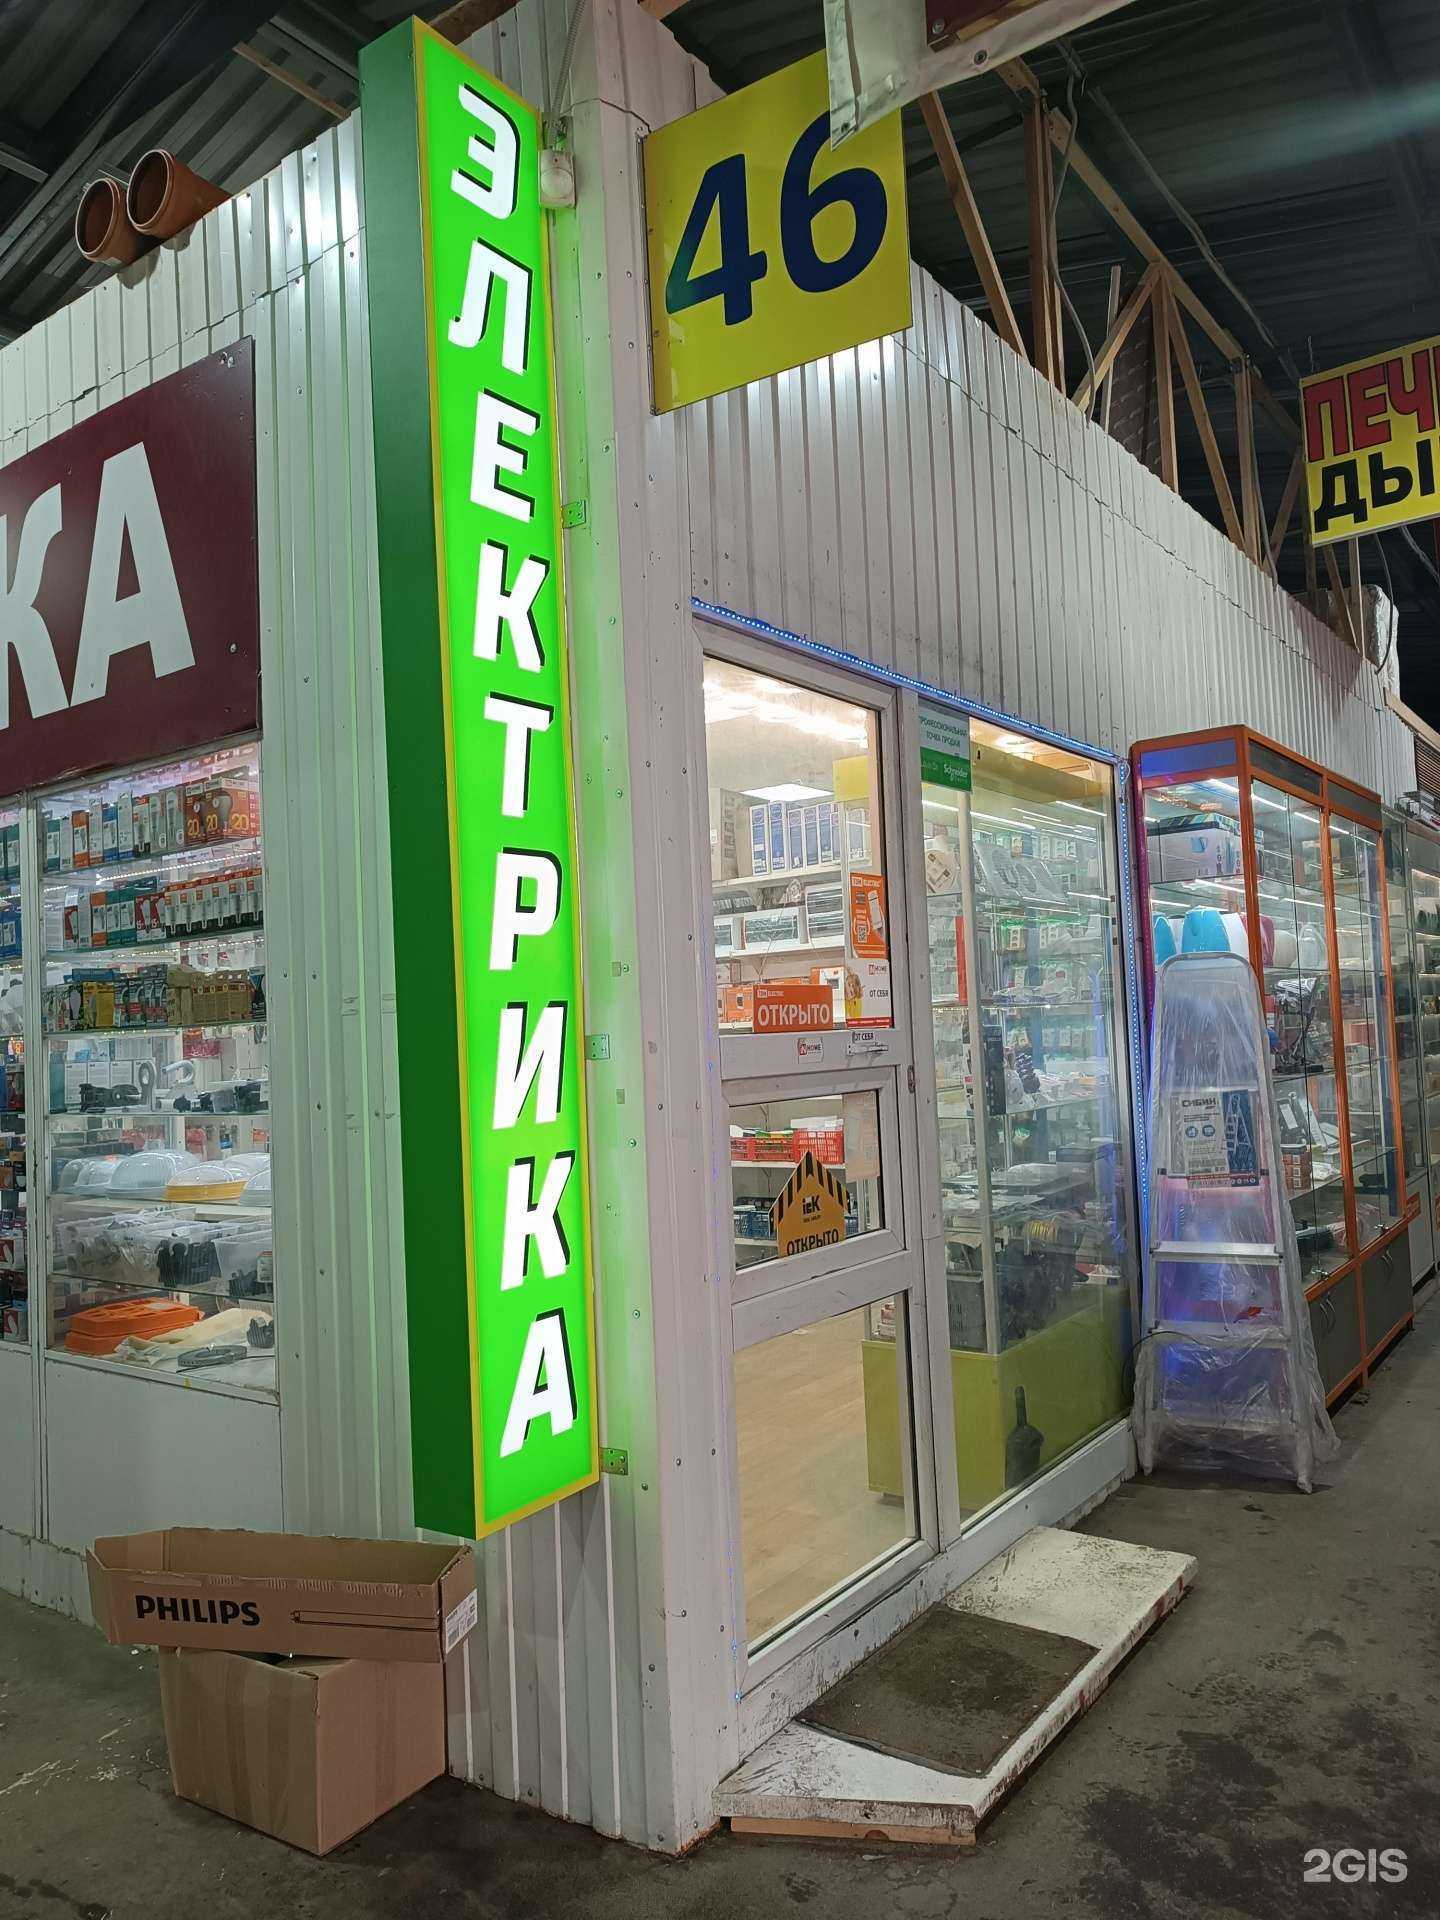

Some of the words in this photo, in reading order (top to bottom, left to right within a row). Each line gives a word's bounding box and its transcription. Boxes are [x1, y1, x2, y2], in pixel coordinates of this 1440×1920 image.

[665, 109, 888, 326] 46
[1302, 345, 1440, 463] ПЕЧ
[447, 82, 577, 1458] ЭЛЕКТРИКА
[757, 1004, 830, 1026] ОТКРЫТО
[786, 1228, 840, 1256] ОТКРЫТО
[134, 1595, 261, 1627] PHILIPS
